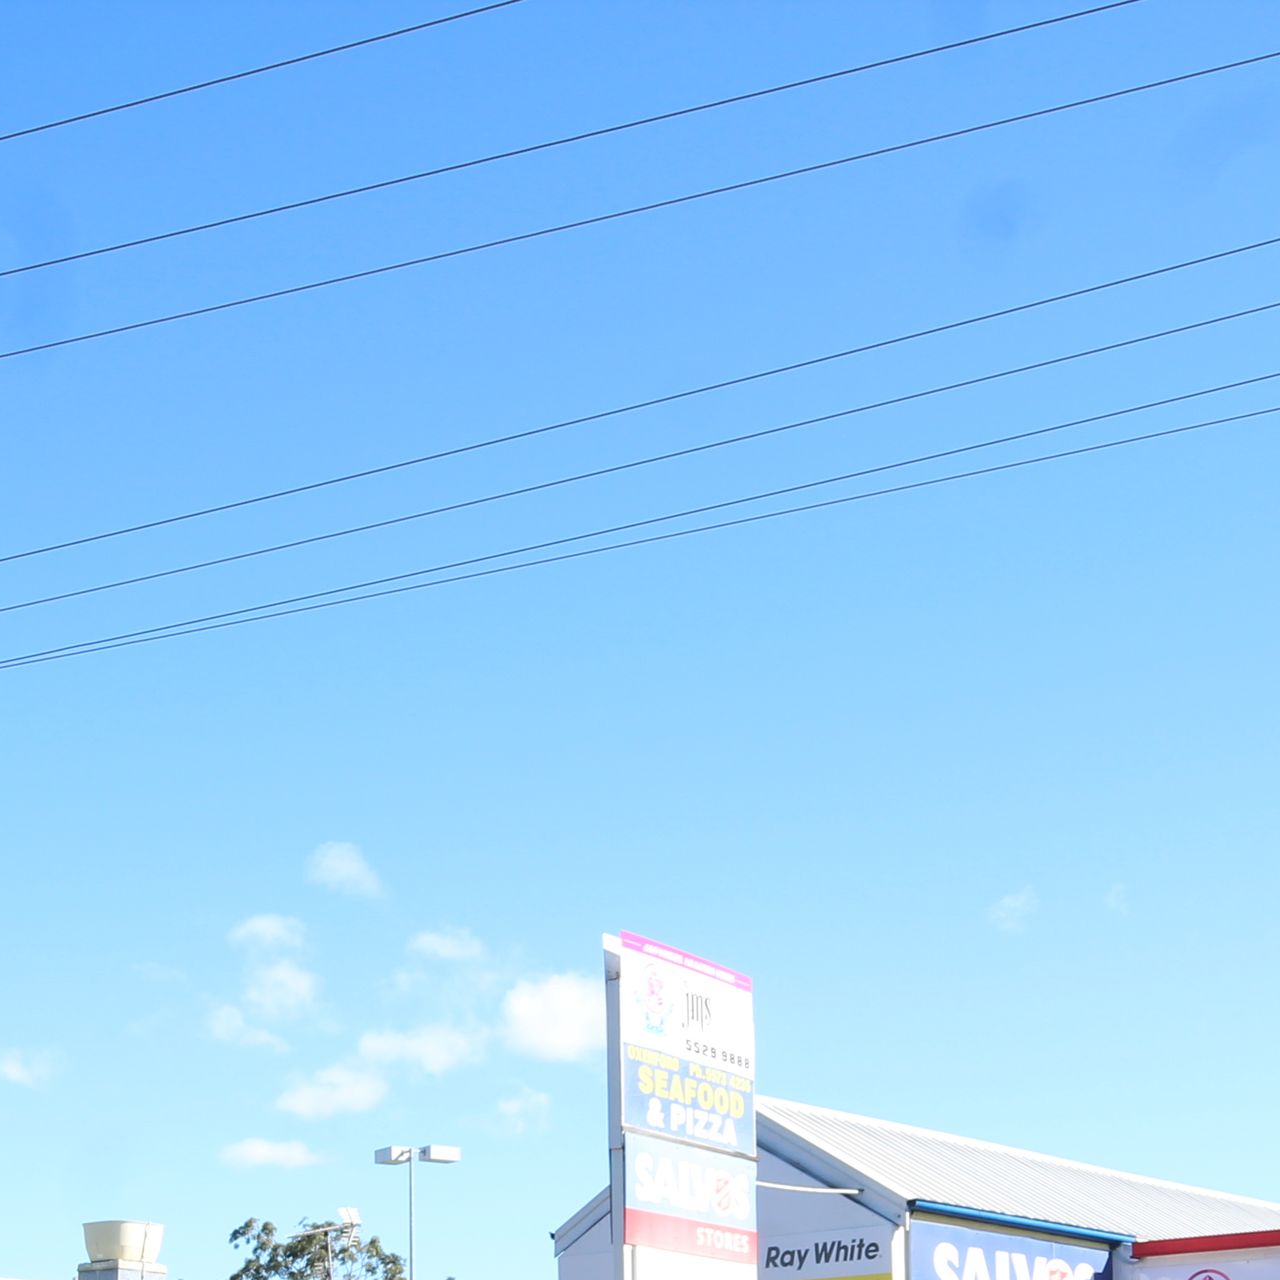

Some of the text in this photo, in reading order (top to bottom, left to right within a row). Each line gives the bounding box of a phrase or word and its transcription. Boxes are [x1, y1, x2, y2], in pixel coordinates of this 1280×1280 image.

[686, 1040, 750, 1069] 5529 9888
[638, 1065, 744, 1119] SEAFOOD
[646, 1098, 738, 1146] & PIZZA
[635, 1152, 751, 1221] SALVOS
[696, 1226, 750, 1254] STORES
[765, 1238, 880, 1270] Ray White
